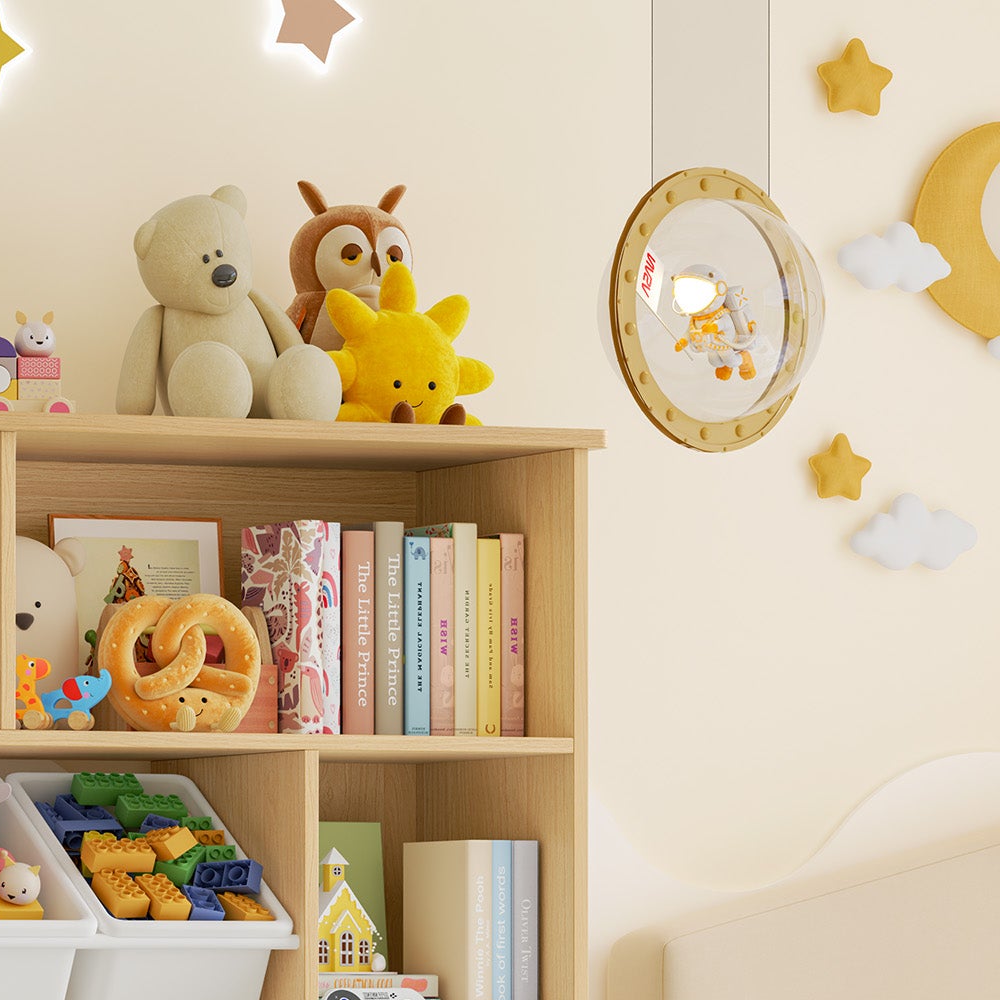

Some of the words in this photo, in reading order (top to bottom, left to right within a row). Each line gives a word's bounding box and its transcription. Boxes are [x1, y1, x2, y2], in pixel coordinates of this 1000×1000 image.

[358, 561, 370, 593] The
[388, 553, 400, 587] The
[358, 598, 370, 646] Little
[388, 592, 400, 642] Little
[358, 651, 370, 707] Prince
[388, 647, 400, 706] Prince
[475, 875, 485, 913] Pooh
[496, 866, 506, 916] words
[475, 918, 485, 945] The
[496, 920, 506, 949] first
[475, 948, 485, 997] Winnie
[496, 954, 506, 970] of
